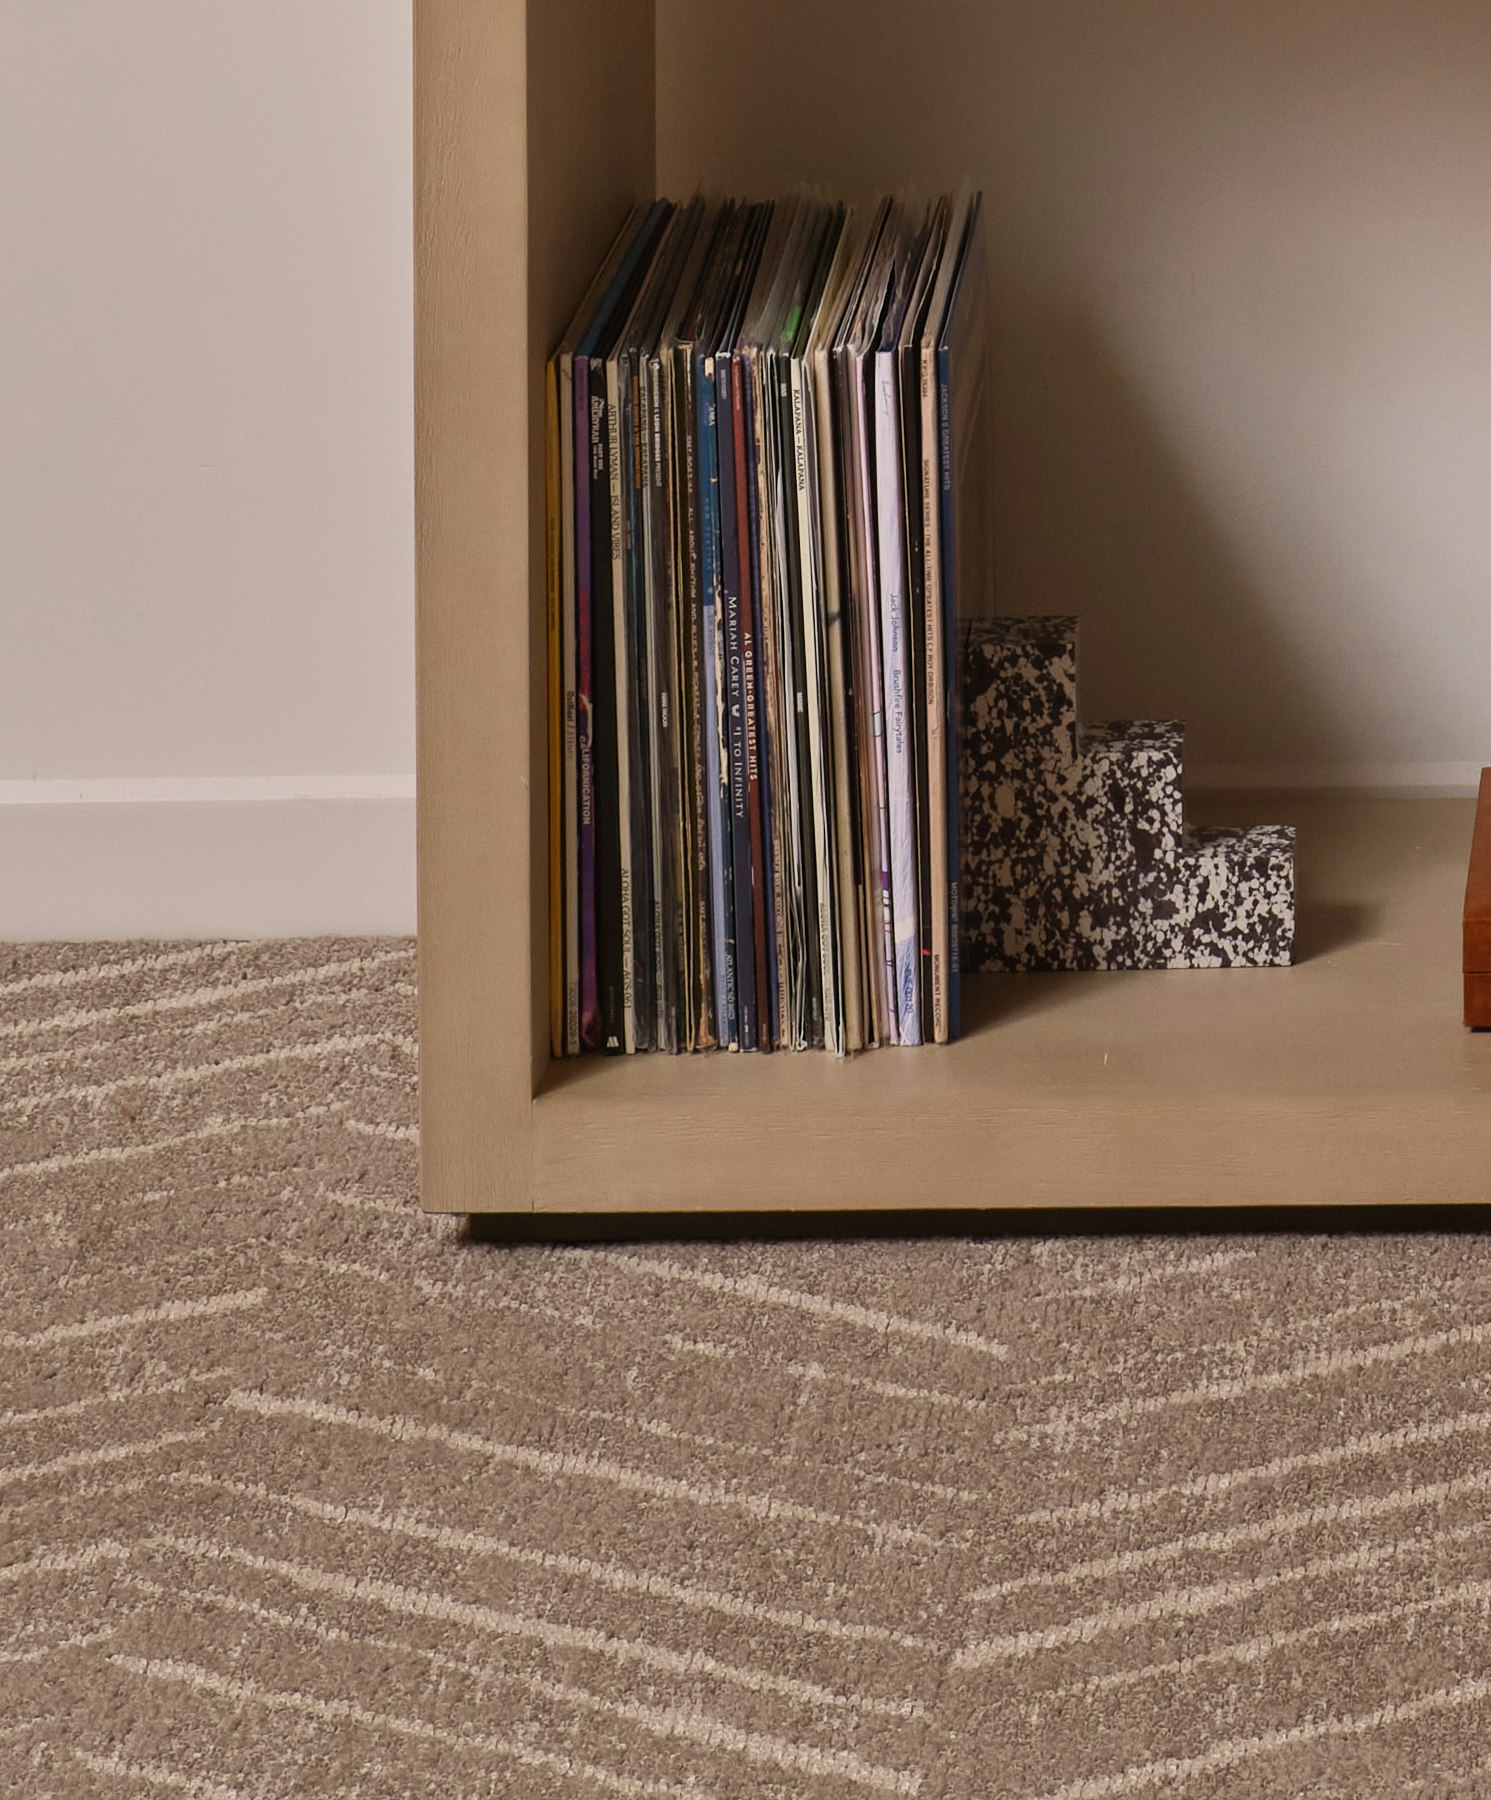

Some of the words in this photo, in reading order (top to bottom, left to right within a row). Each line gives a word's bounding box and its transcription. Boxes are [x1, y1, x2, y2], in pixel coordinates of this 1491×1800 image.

[793, 389, 802, 435] KALAPANA
[940, 383, 949, 422] JACKSON
[607, 404, 618, 444] ARTHUR
[609, 447, 619, 481] LYMAN
[795, 445, 805, 492] KALAPANA
[942, 430, 950, 470] GREATEST
[610, 495, 621, 531] ISLAND
[611, 533, 621, 561] VIBES
[889, 593, 899, 614] Jack
[728, 596, 738, 651] MARIAH
[890, 616, 900, 653] Johnson
[731, 655, 740, 698] CAREY
[892, 670, 902, 709] Brushfire
[743, 632, 752, 646] AL
[749, 755, 758, 781] HITS
[733, 742, 742, 758] TO
[892, 712, 903, 754] Fairytales
[578, 735, 591, 826] CALIFORNICATION
[734, 762, 744, 819] INFINITY
[621, 868, 630, 904] ALOHA
[622, 905, 631, 926] GOT
[622, 929, 632, 954] SOUL
[623, 970, 632, 1010] AGS-061
[725, 953, 733, 991] ATLANTIC
